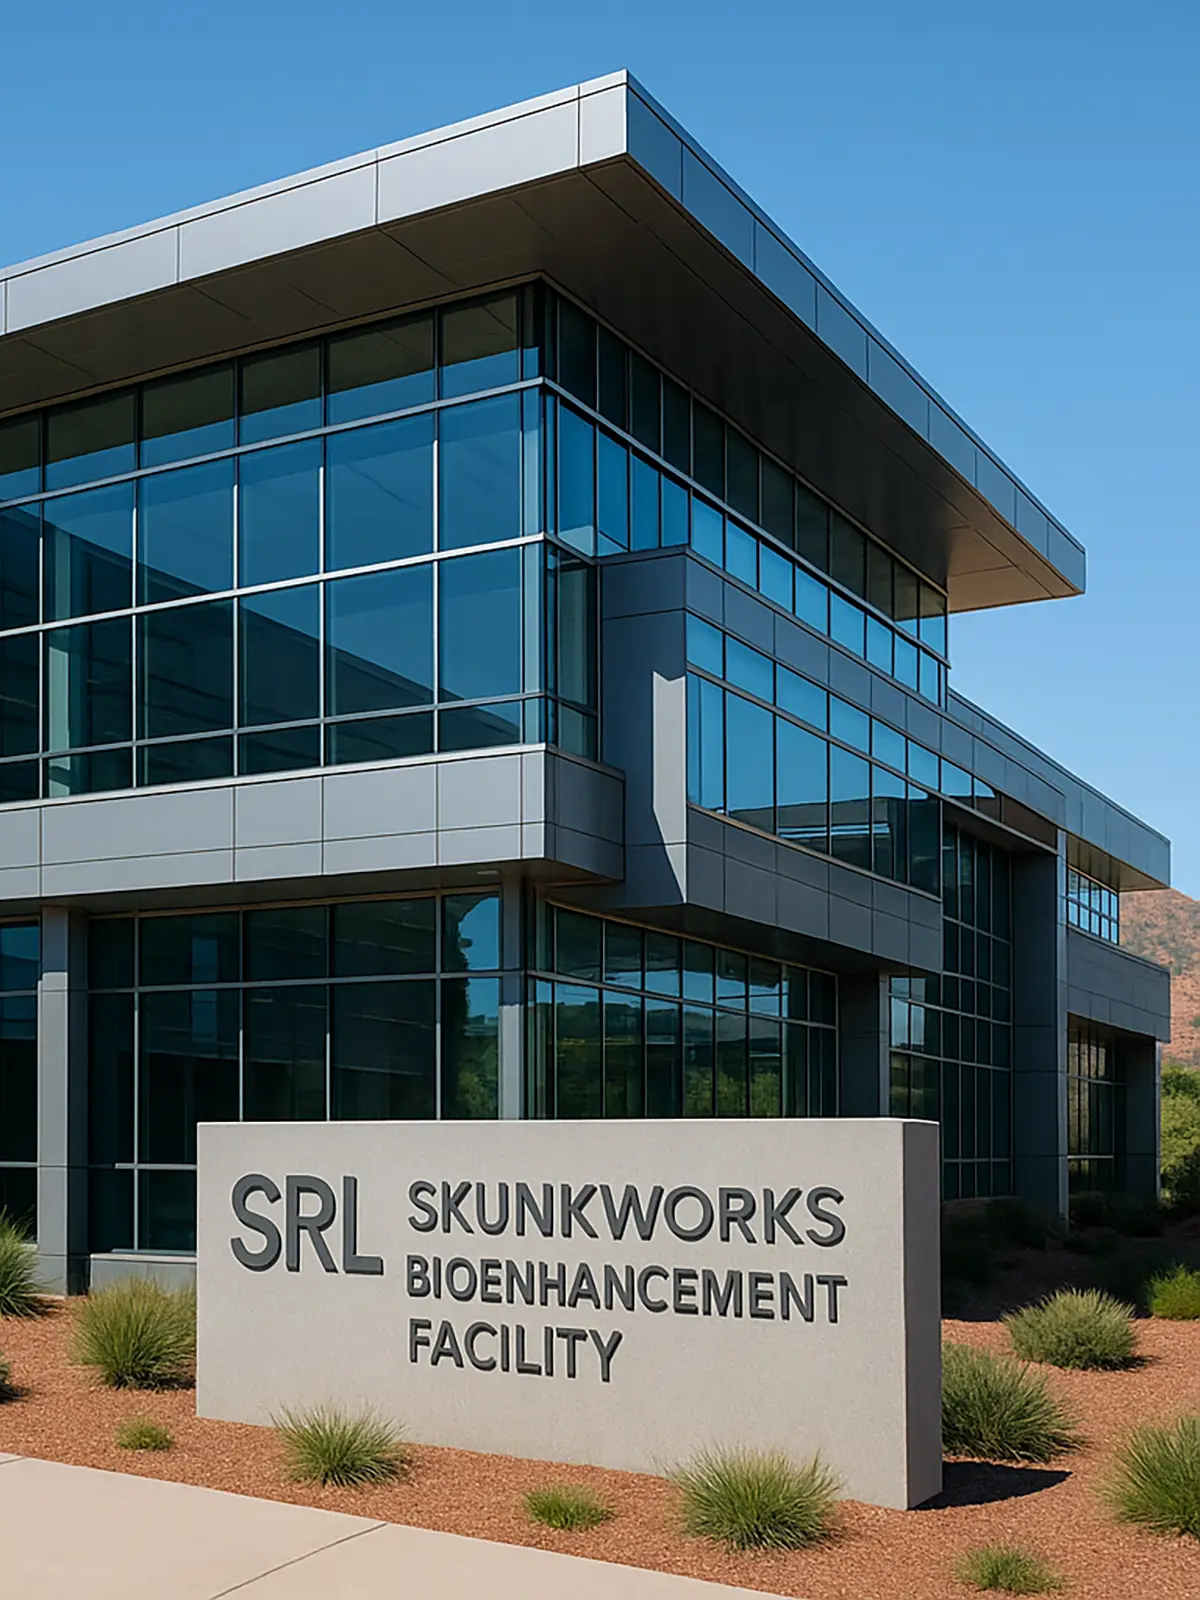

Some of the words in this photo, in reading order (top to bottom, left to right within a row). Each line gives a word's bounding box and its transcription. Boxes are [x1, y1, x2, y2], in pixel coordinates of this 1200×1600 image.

[230, 1173, 385, 1276] SRL
[407, 1180, 846, 1248] SKUNKWORKS
[406, 1254, 849, 1325] BIOENHANCEMENT
[408, 1317, 623, 1384] FACILITY
